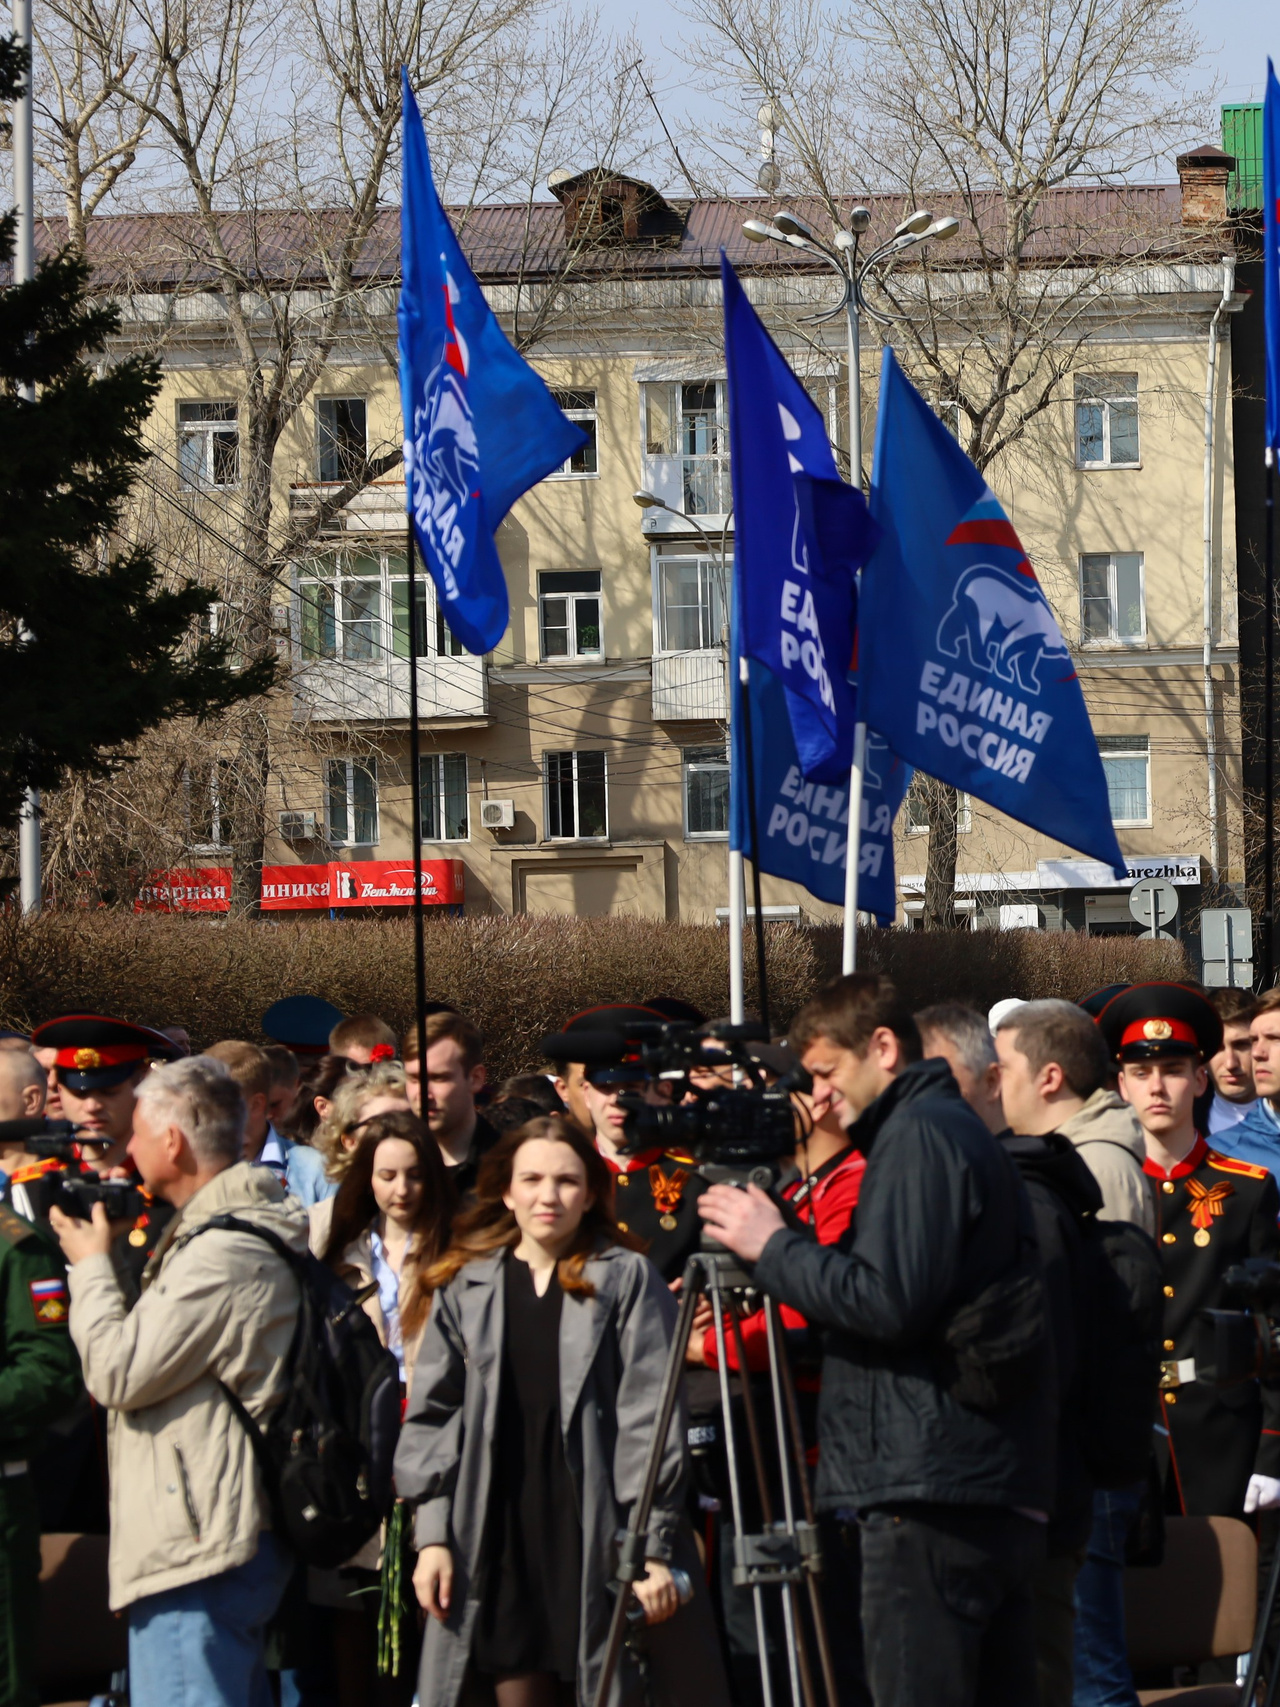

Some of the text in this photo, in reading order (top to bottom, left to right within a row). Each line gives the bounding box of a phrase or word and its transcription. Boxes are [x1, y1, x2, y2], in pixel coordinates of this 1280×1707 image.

[919, 660, 1053, 744] ЕДИНАЯ
[916, 700, 1036, 784] РОССИЯ
[262, 878, 330, 898] иника
[1126, 865, 1197, 878] arezhka
